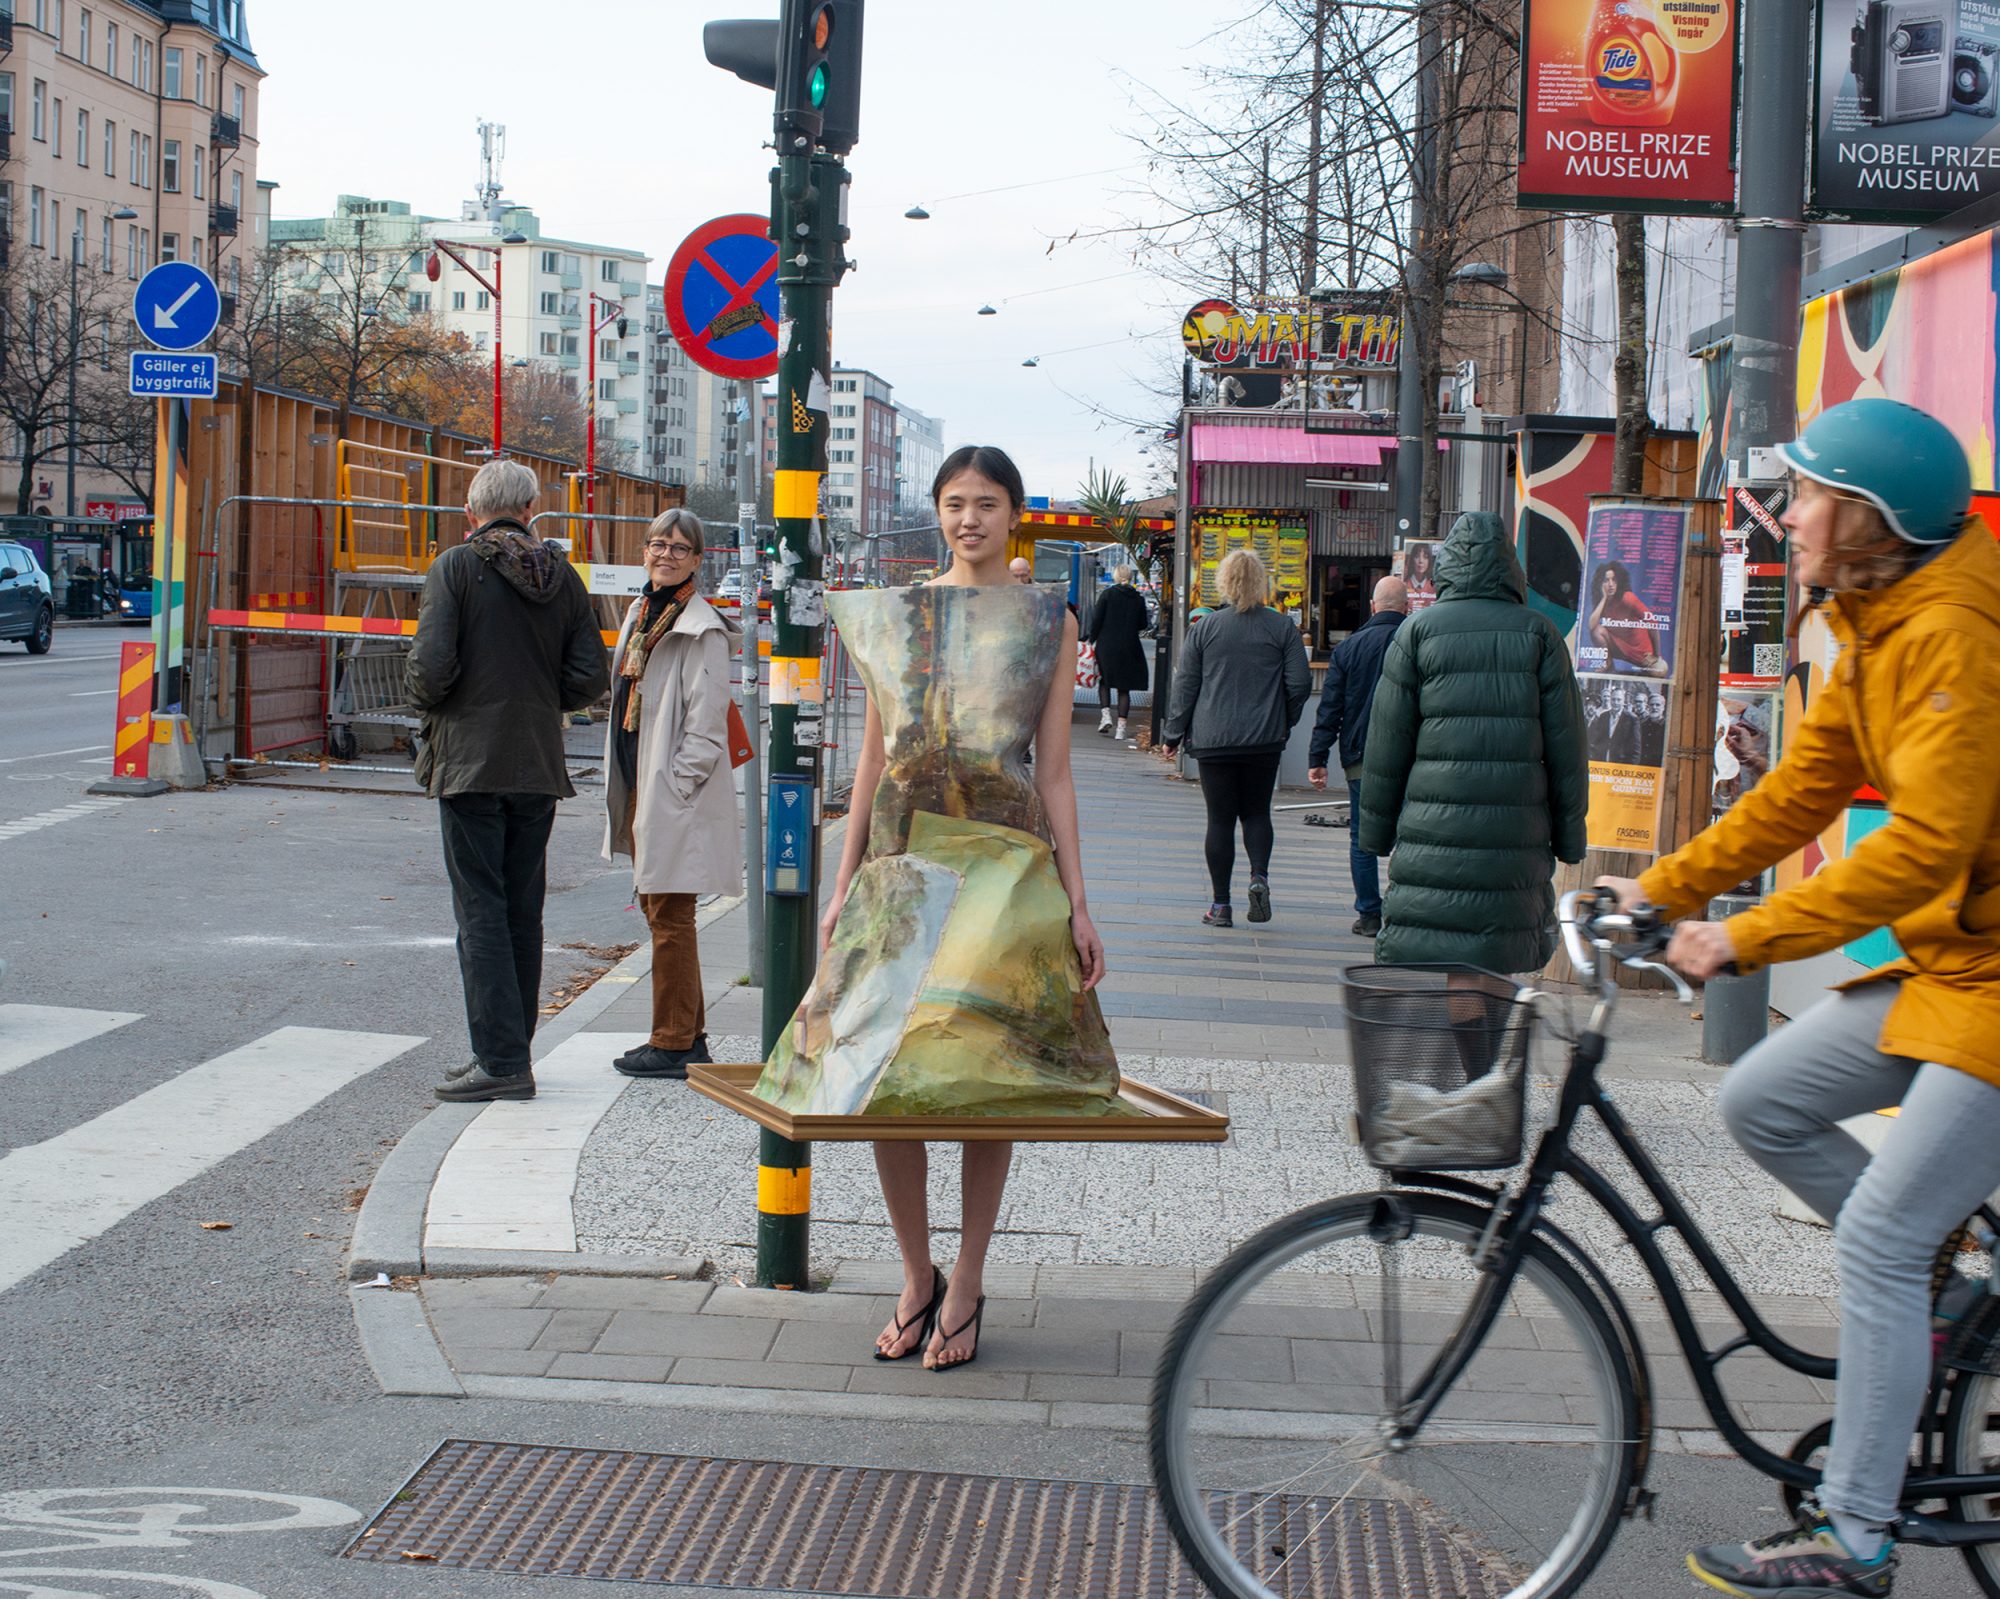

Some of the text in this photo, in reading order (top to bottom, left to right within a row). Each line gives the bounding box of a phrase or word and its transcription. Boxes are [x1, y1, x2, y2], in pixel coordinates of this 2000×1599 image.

[1663, 2, 1720, 14] utställning!
[1960, 0, 2000, 16] UTSTÄLL
[1672, 15, 1709, 27] Visning
[1677, 28, 1704, 38] ingår
[1603, 48, 1637, 72] Tide
[1546, 130, 1711, 156] NOBEL PRIZE
[1838, 142, 2000, 168] NOBEL PRIZE
[1565, 155, 1690, 179] MUSEUM
[1857, 167, 1980, 192] MUSEUM
[143, 359, 206, 376] Gäller ej
[135, 375, 212, 391] byggtrafik
[1763, 489, 1785, 512] SWEDEN
[1738, 490, 1783, 539] PANCRASE
[595, 572, 616, 580] Infart
[1744, 565, 1760, 575] RT
[1601, 617, 1670, 631] Morelenbaum
[1644, 611, 1670, 623] Dora
[1580, 646, 1608, 660] ASCHING
[1611, 768, 1656, 780] CARLSON
[1616, 827, 1650, 839] FASCHING
